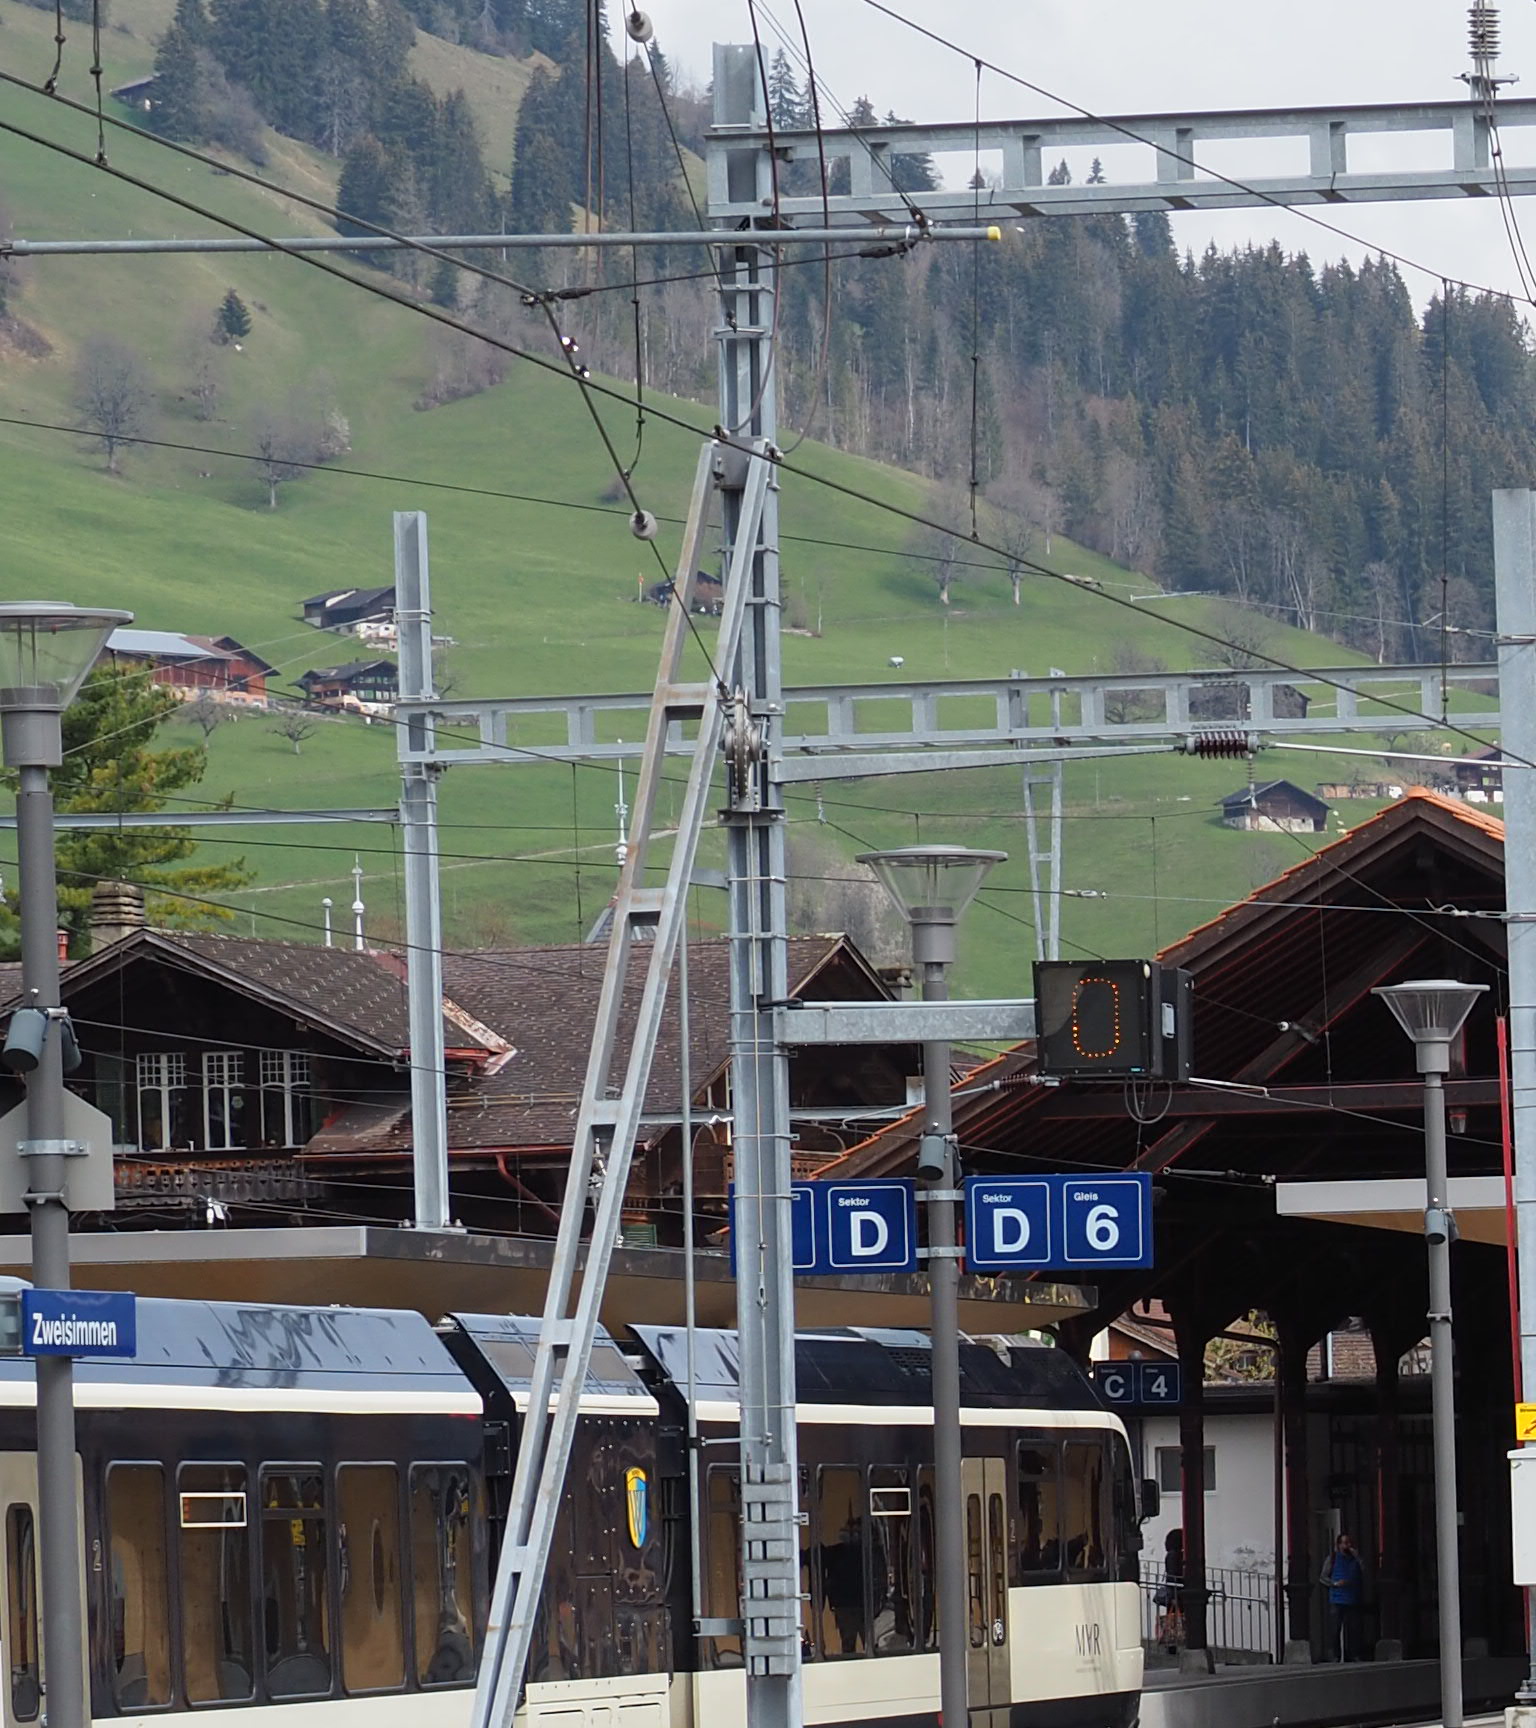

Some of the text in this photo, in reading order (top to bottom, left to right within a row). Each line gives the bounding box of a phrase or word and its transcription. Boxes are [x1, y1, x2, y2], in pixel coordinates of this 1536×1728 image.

[838, 1197, 870, 1207] Sektor
[982, 1193, 1013, 1203] Sektor
[1073, 1192, 1099, 1202] Gleis
[850, 1211, 889, 1256] D
[993, 1208, 1030, 1253] D
[1085, 1204, 1120, 1251] 6
[32, 1312, 117, 1346] Zweisimmen
[1104, 1374, 1125, 1398] C
[1151, 1375, 1168, 1398] 4
